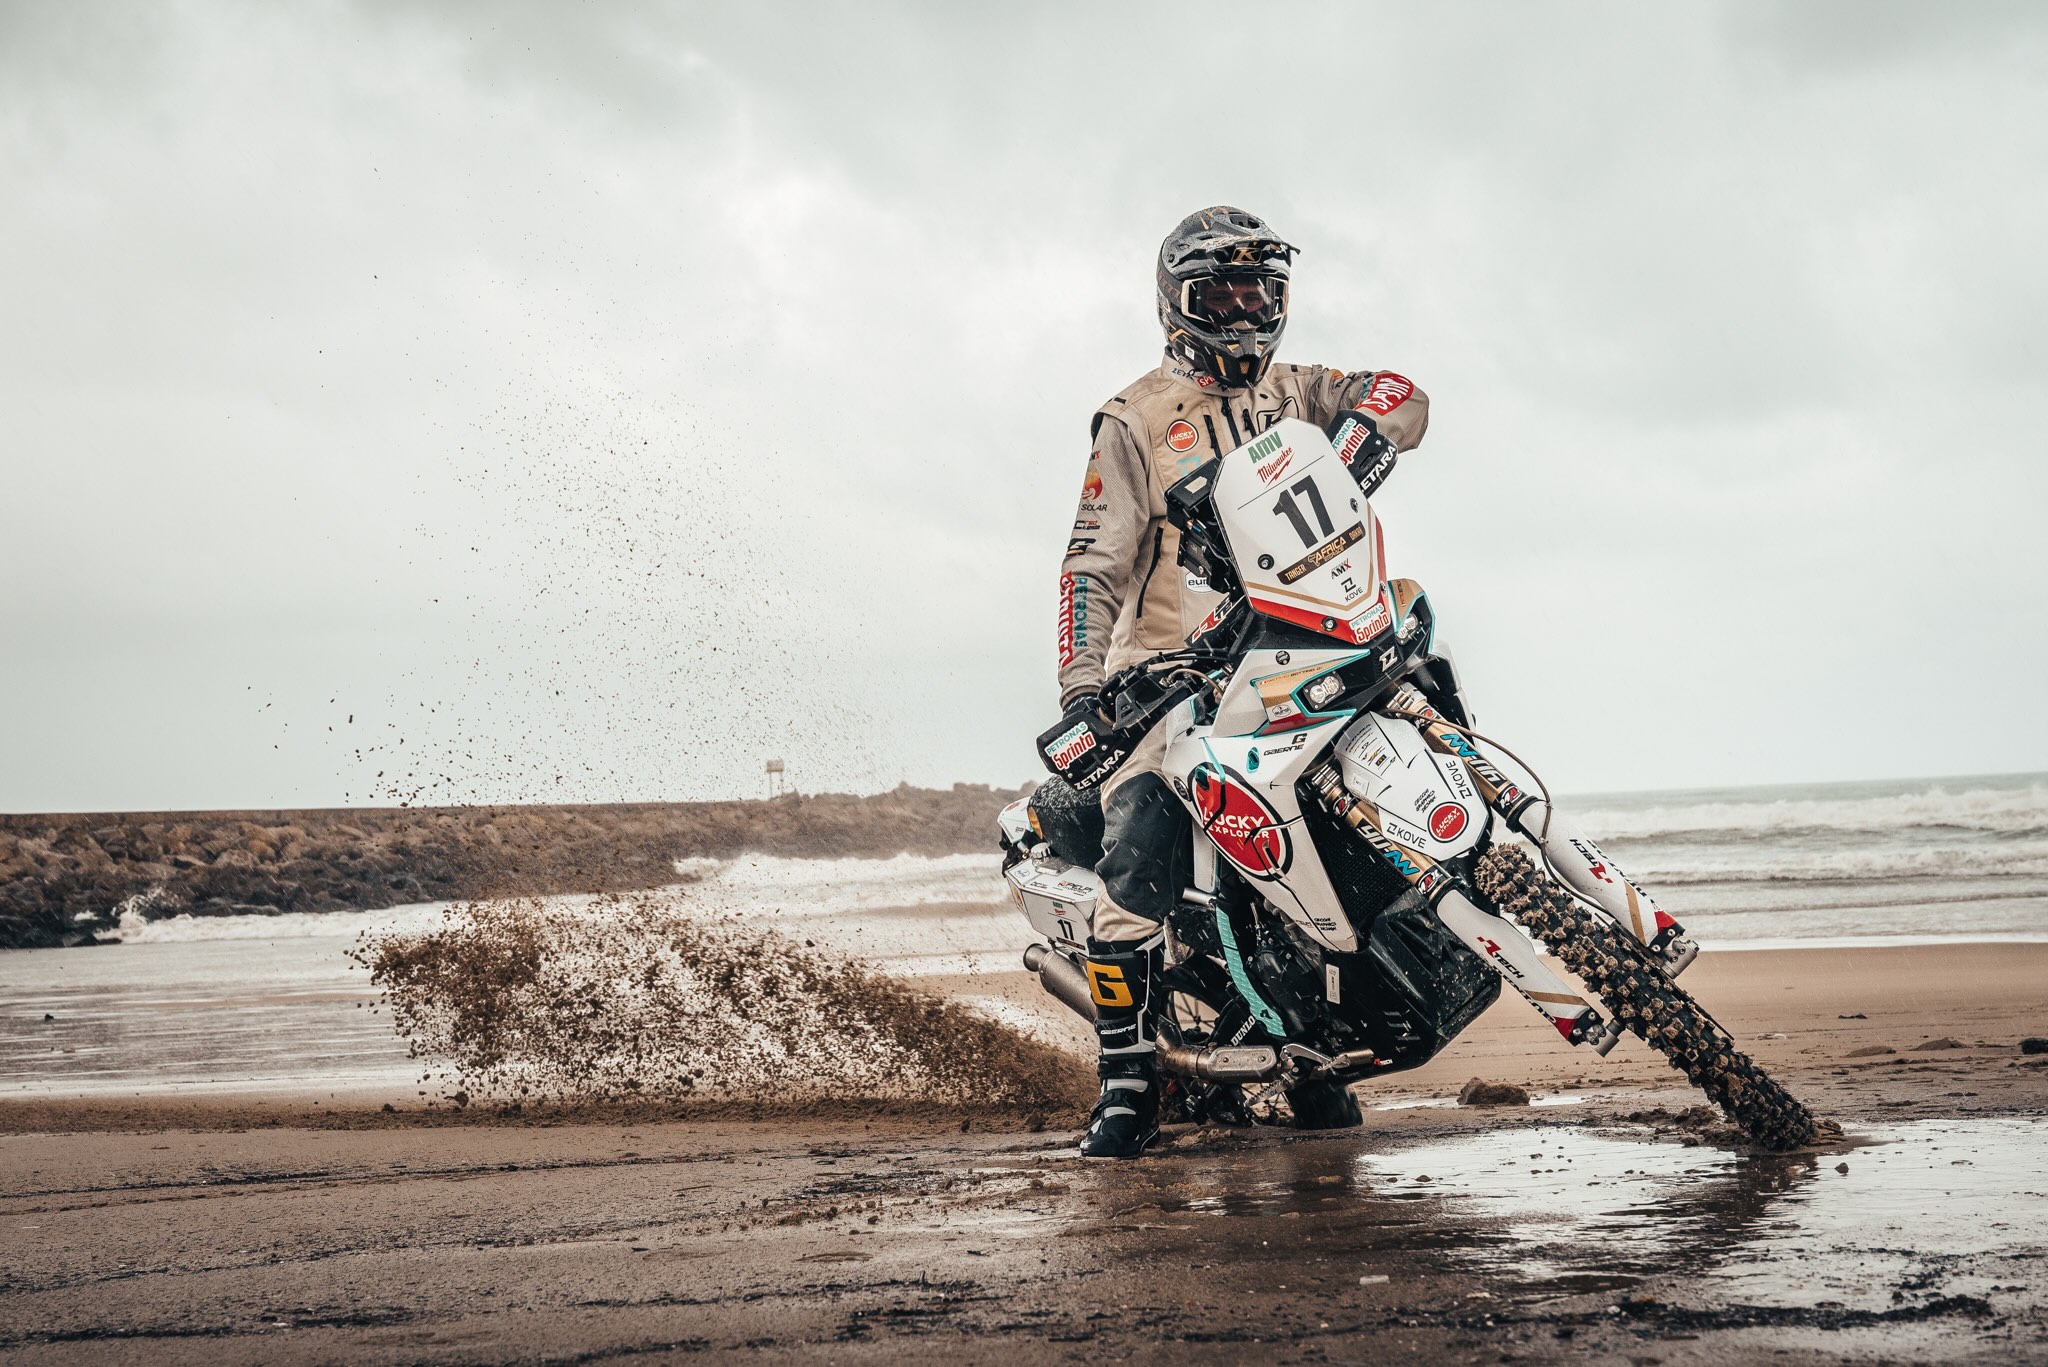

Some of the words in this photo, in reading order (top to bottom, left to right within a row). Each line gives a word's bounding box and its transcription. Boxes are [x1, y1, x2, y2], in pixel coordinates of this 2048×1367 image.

[1170, 430, 1194, 440] LUCKY
[1248, 431, 1284, 464] AMV
[1332, 419, 1356, 449] TRONAS
[1256, 446, 1294, 484] Milwaukee
[1359, 445, 1396, 492] ETARA
[1272, 475, 1336, 549] 17
[1285, 563, 1307, 581] TANGER
[1315, 536, 1347, 566] AFRICA
[1331, 558, 1352, 580] AMX
[1345, 587, 1364, 602] KOVE
[1073, 577, 1088, 647] PETRONAS
[1351, 604, 1384, 629] PETRONAS
[1356, 614, 1389, 642] Sprinta
[1046, 723, 1087, 756] PETRONAS
[1053, 733, 1095, 769] Sprinta
[1074, 749, 1125, 790] ZETARA
[1446, 760, 1467, 788] KOVE
[1203, 806, 1265, 830] LUCKY
[1204, 821, 1270, 839] EXPLORR
[1436, 808, 1457, 833] LUCKY
[1356, 824, 1421, 877] YU-AN
[1396, 827, 1427, 849] KOVE
[1057, 919, 1075, 941] 17
[1086, 960, 1134, 1007] G
[1230, 1015, 1256, 1047] DUNLO
